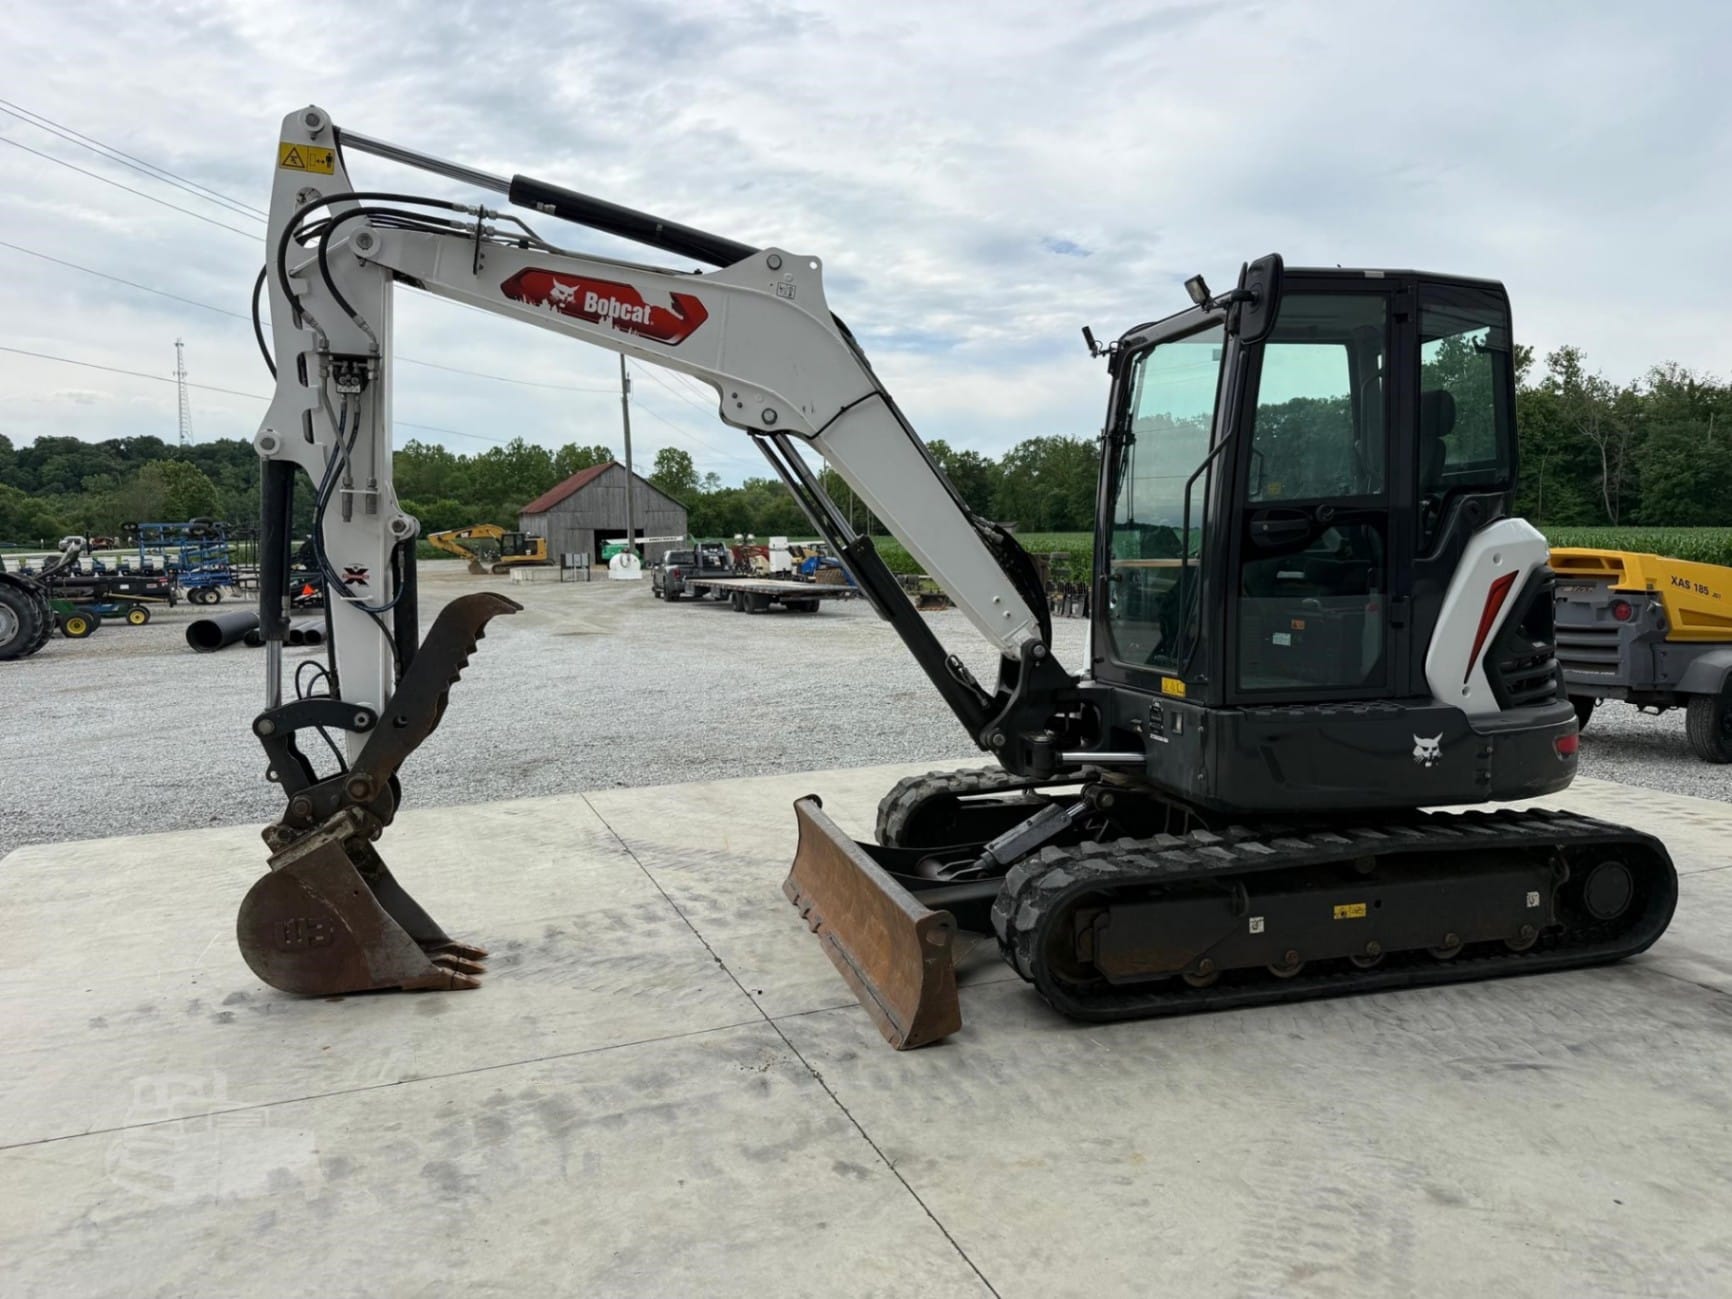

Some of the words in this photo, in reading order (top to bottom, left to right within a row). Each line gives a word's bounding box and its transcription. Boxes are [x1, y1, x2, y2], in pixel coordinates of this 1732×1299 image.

[585, 292, 651, 324] Bobcat
[1671, 575, 1691, 590] XAS
[1693, 583, 1710, 596] 185
